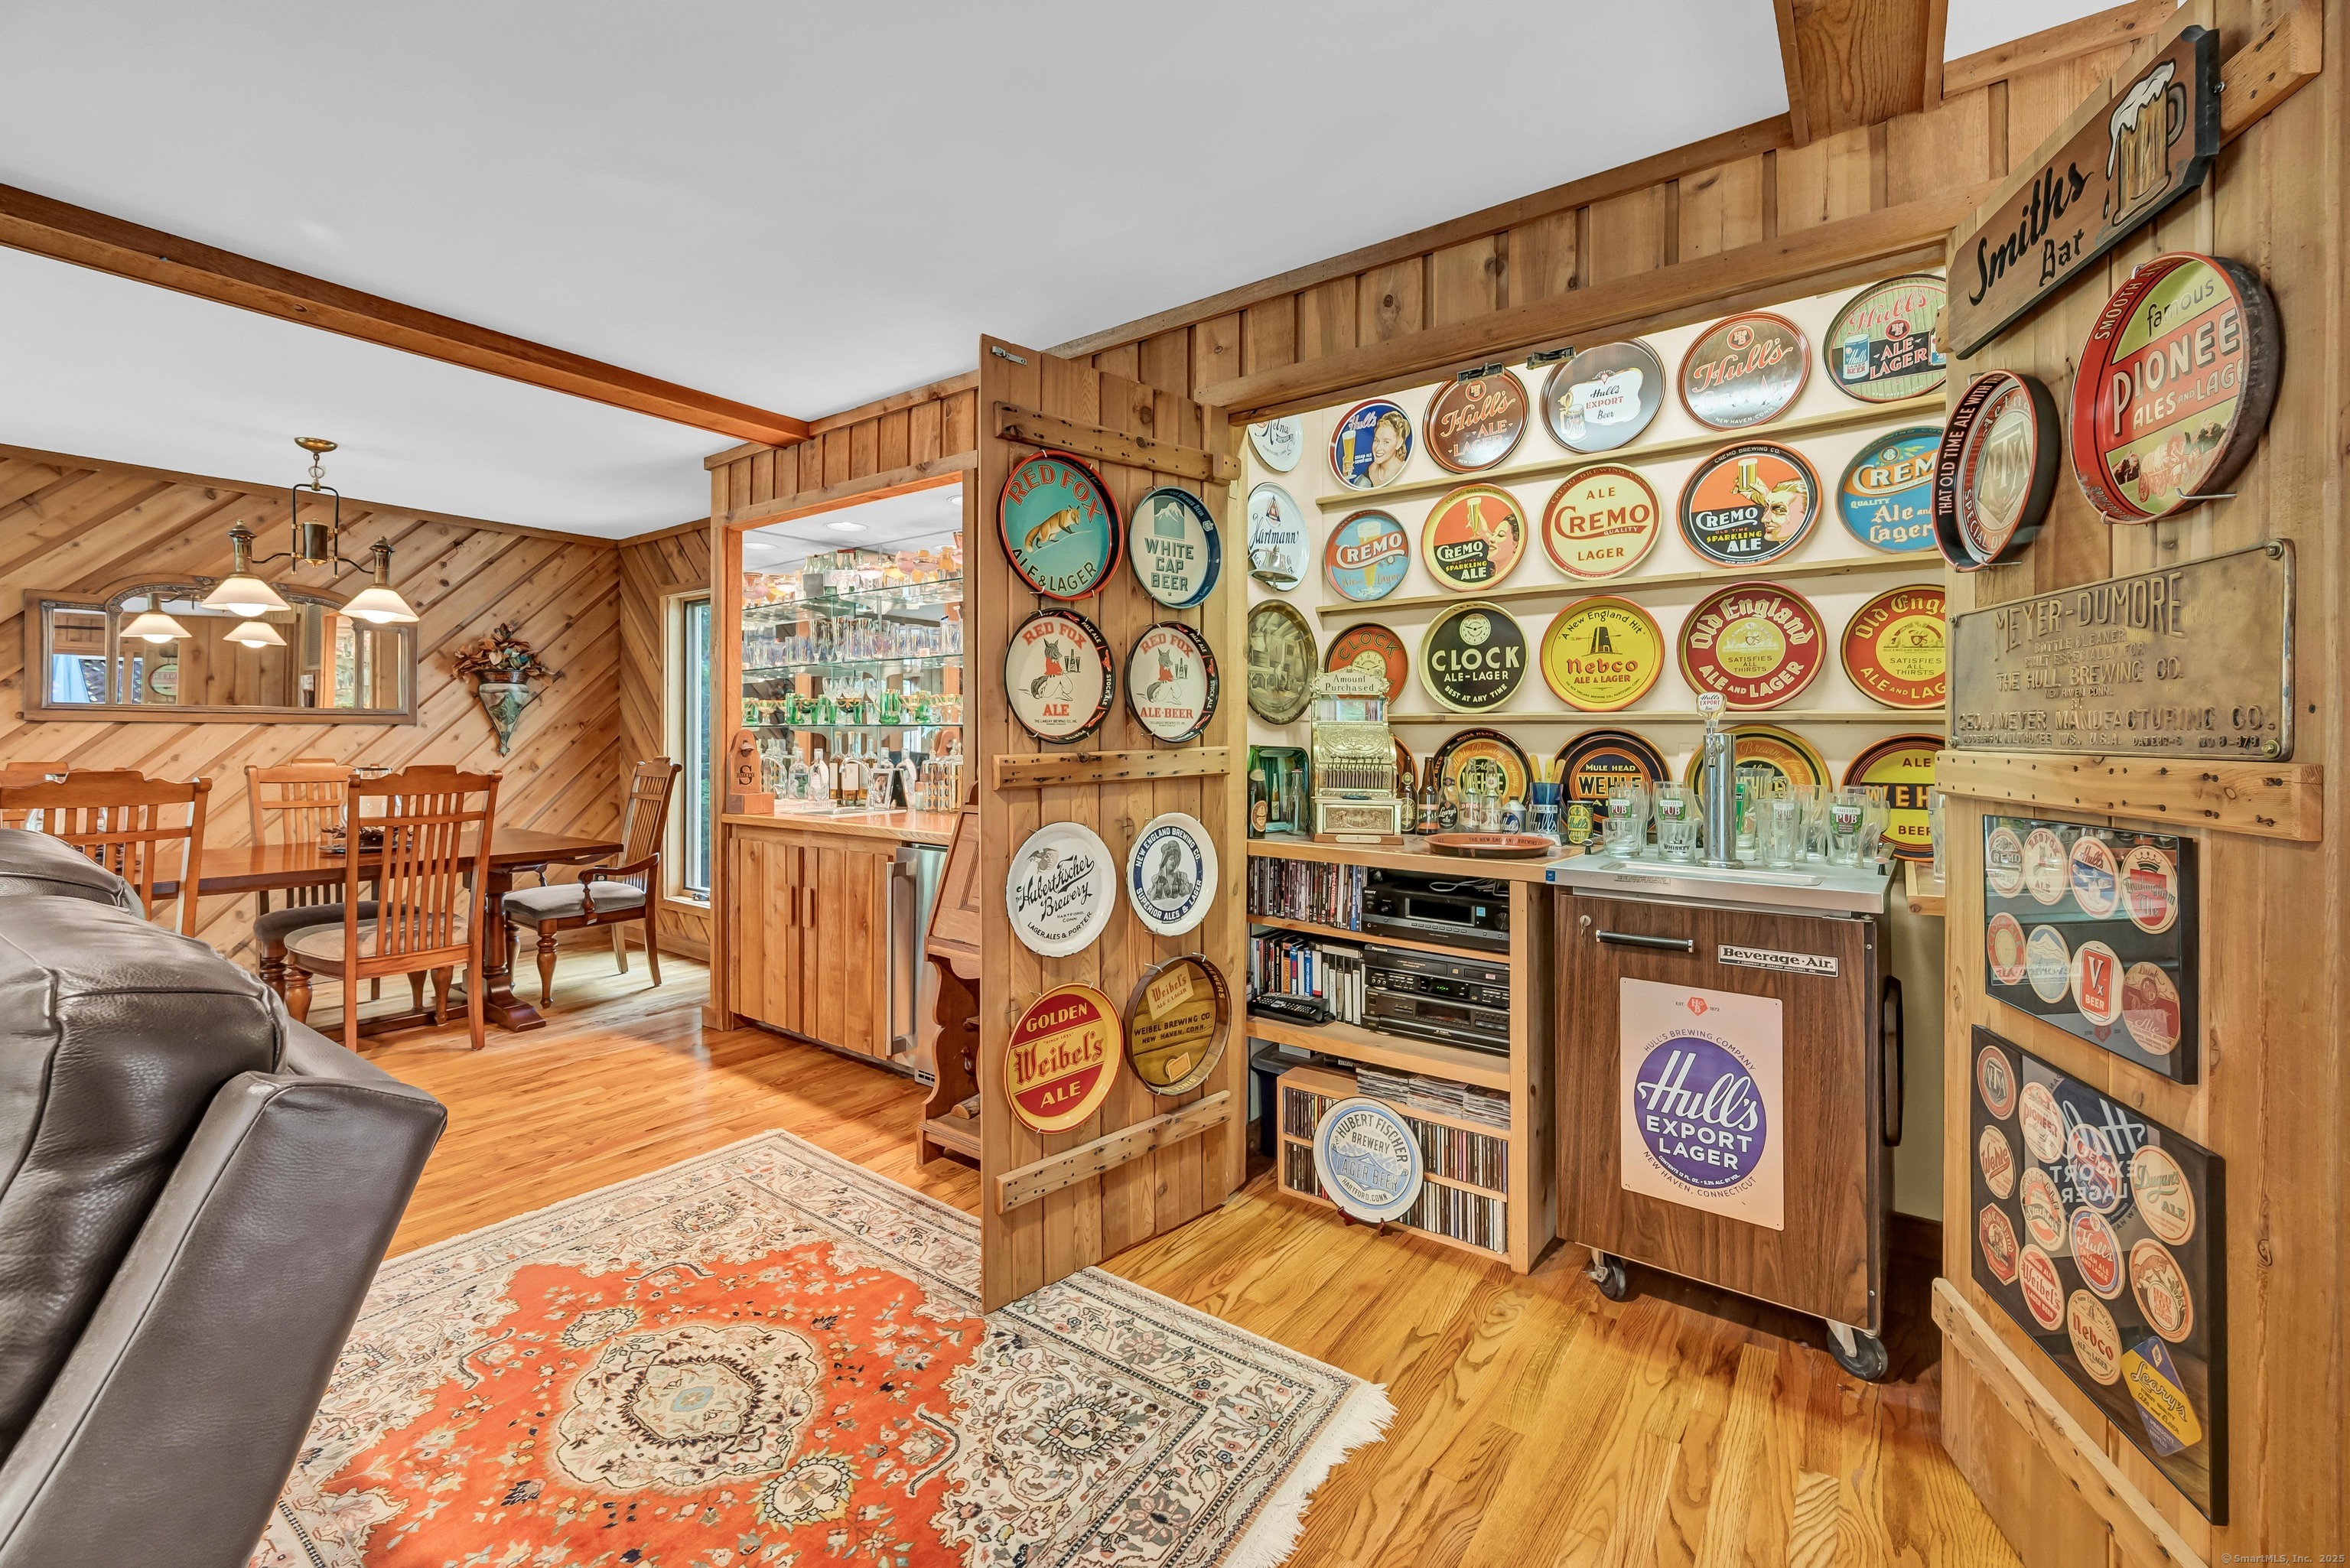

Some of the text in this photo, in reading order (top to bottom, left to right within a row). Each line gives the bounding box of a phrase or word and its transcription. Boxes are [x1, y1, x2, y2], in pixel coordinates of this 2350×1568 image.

[1968, 162, 2094, 305] Smiths
[2039, 228, 2085, 288] Bar
[1847, 289, 1937, 336] Hull's
[2094, 282, 2142, 340] SMOOTH
[2147, 278, 2214, 337] famous
[1880, 337, 1914, 361] ALE
[1692, 338, 1794, 393] Hull's
[1847, 366, 1866, 375] BEER
[1870, 347, 1927, 380] LAGER
[2113, 308, 2241, 437] PIONEE
[1586, 395, 1623, 411] EXPORT
[1590, 385, 1620, 399] Hull's
[1440, 390, 1516, 438] Hull's
[1597, 410, 1614, 421] Beer
[2133, 391, 2176, 430] ALES
[1476, 419, 1508, 438] ALE
[1453, 434, 1503, 457] LAGER
[1714, 451, 1736, 464] CREMO
[1938, 381, 1993, 516] THAT OLD TIME ALE WITH
[1007, 464, 1056, 506] RED
[1060, 469, 1102, 523] FOX
[1446, 492, 1465, 504] CREMO
[1551, 468, 1625, 504] CREMO BREWING
[1586, 487, 1616, 499] ALE
[1850, 498, 1890, 509] QUALITY
[1871, 504, 1913, 523] Ale
[1554, 504, 1650, 539] CREMO
[1603, 526, 1639, 535] QUALITY
[1696, 507, 1758, 531] CREMO
[1964, 487, 1987, 549] SPECIAL
[1707, 531, 1762, 543] SPARKLING
[1727, 538, 1762, 553] ALE
[1870, 523, 1934, 544] Lager
[1144, 538, 1194, 560] WHITE
[1437, 542, 1483, 561] CREMO
[1577, 548, 1624, 561] LAGER
[1050, 561, 1098, 592] LAGER
[1156, 556, 1184, 574] CAP
[1446, 561, 1487, 572] SPARKLING
[1460, 567, 1487, 580] ALE
[1151, 572, 1188, 591] BEER
[1567, 610, 1642, 634] New England Hit
[1690, 597, 1814, 649] Old England
[1854, 607, 1889, 639] Old
[1994, 571, 2185, 662] MEYER-DUMORE
[1021, 621, 1087, 649] RED FOX
[1140, 633, 1194, 659] RED FOX
[1339, 632, 1399, 659] CLOCK
[2075, 629, 2127, 647] CLEANER
[1431, 646, 1520, 672] CLOCK
[1566, 658, 1639, 675] Nebco
[1325, 683, 1374, 691] Purchased
[1333, 675, 1365, 683] Amount
[1699, 661, 1805, 698] ALE AND LAGER
[1860, 667, 1909, 695] ALE AND
[1444, 685, 1460, 698] BEST
[1473, 695, 1487, 703] ANY
[1490, 683, 1508, 698] TIME
[1043, 704, 1069, 716] ALE
[2055, 705, 2216, 732] MANUFACTURING
[2004, 731, 2052, 744] MILWAUKEE
[1585, 763, 1607, 772] MULE
[1902, 758, 1932, 767] ALE
[1611, 805, 1627, 814] PUB
[1662, 806, 1681, 815] PUB
[1835, 814, 1857, 824] PUB
[1135, 849, 1146, 867] NEW
[1144, 828, 1170, 850] ENGLAND
[1172, 828, 1196, 849] BREWING
[1056, 854, 1095, 894] Fischer
[1040, 882, 1093, 922] Brewery
[1136, 880, 1202, 920] SUPERIOR ALES LAGER
[1069, 912, 1092, 936] PORTER
[1151, 973, 1186, 1003] Weibel's
[1203, 963, 1225, 999] BREWERS
[1156, 988, 1186, 1010] ALE LAGER
[2085, 994, 2104, 1011] BEER
[1026, 1003, 1088, 1032] GOLDEN
[1134, 1012, 1212, 1036] WEIBEL BREWING CO.
[1142, 1023, 1206, 1044] NEW CONN.
[1014, 1030, 1104, 1085] Weibel's
[1644, 1029, 1756, 1070] HULL'S BREWING COMPANY
[1040, 1081, 1081, 1108] ALE
[1637, 1049, 1759, 1132] Hull's
[1337, 1114, 1408, 1163] HUBERT FISCHER
[1352, 1132, 1390, 1154] BREWERY
[1646, 1115, 1753, 1153] EXPORT
[1658, 1156, 1679, 1174] CONTENTS
[1659, 1137, 1738, 1169] LAGER
[1981, 1142, 2010, 1182] Wehle
[1336, 1156, 1398, 1192] LAGER BEER
[1643, 1151, 1756, 1198] NEW HAVEN, CONNECTICUT
[2077, 1226, 2113, 1262] Hull's
[2021, 1260, 2061, 1311] Weibel's
